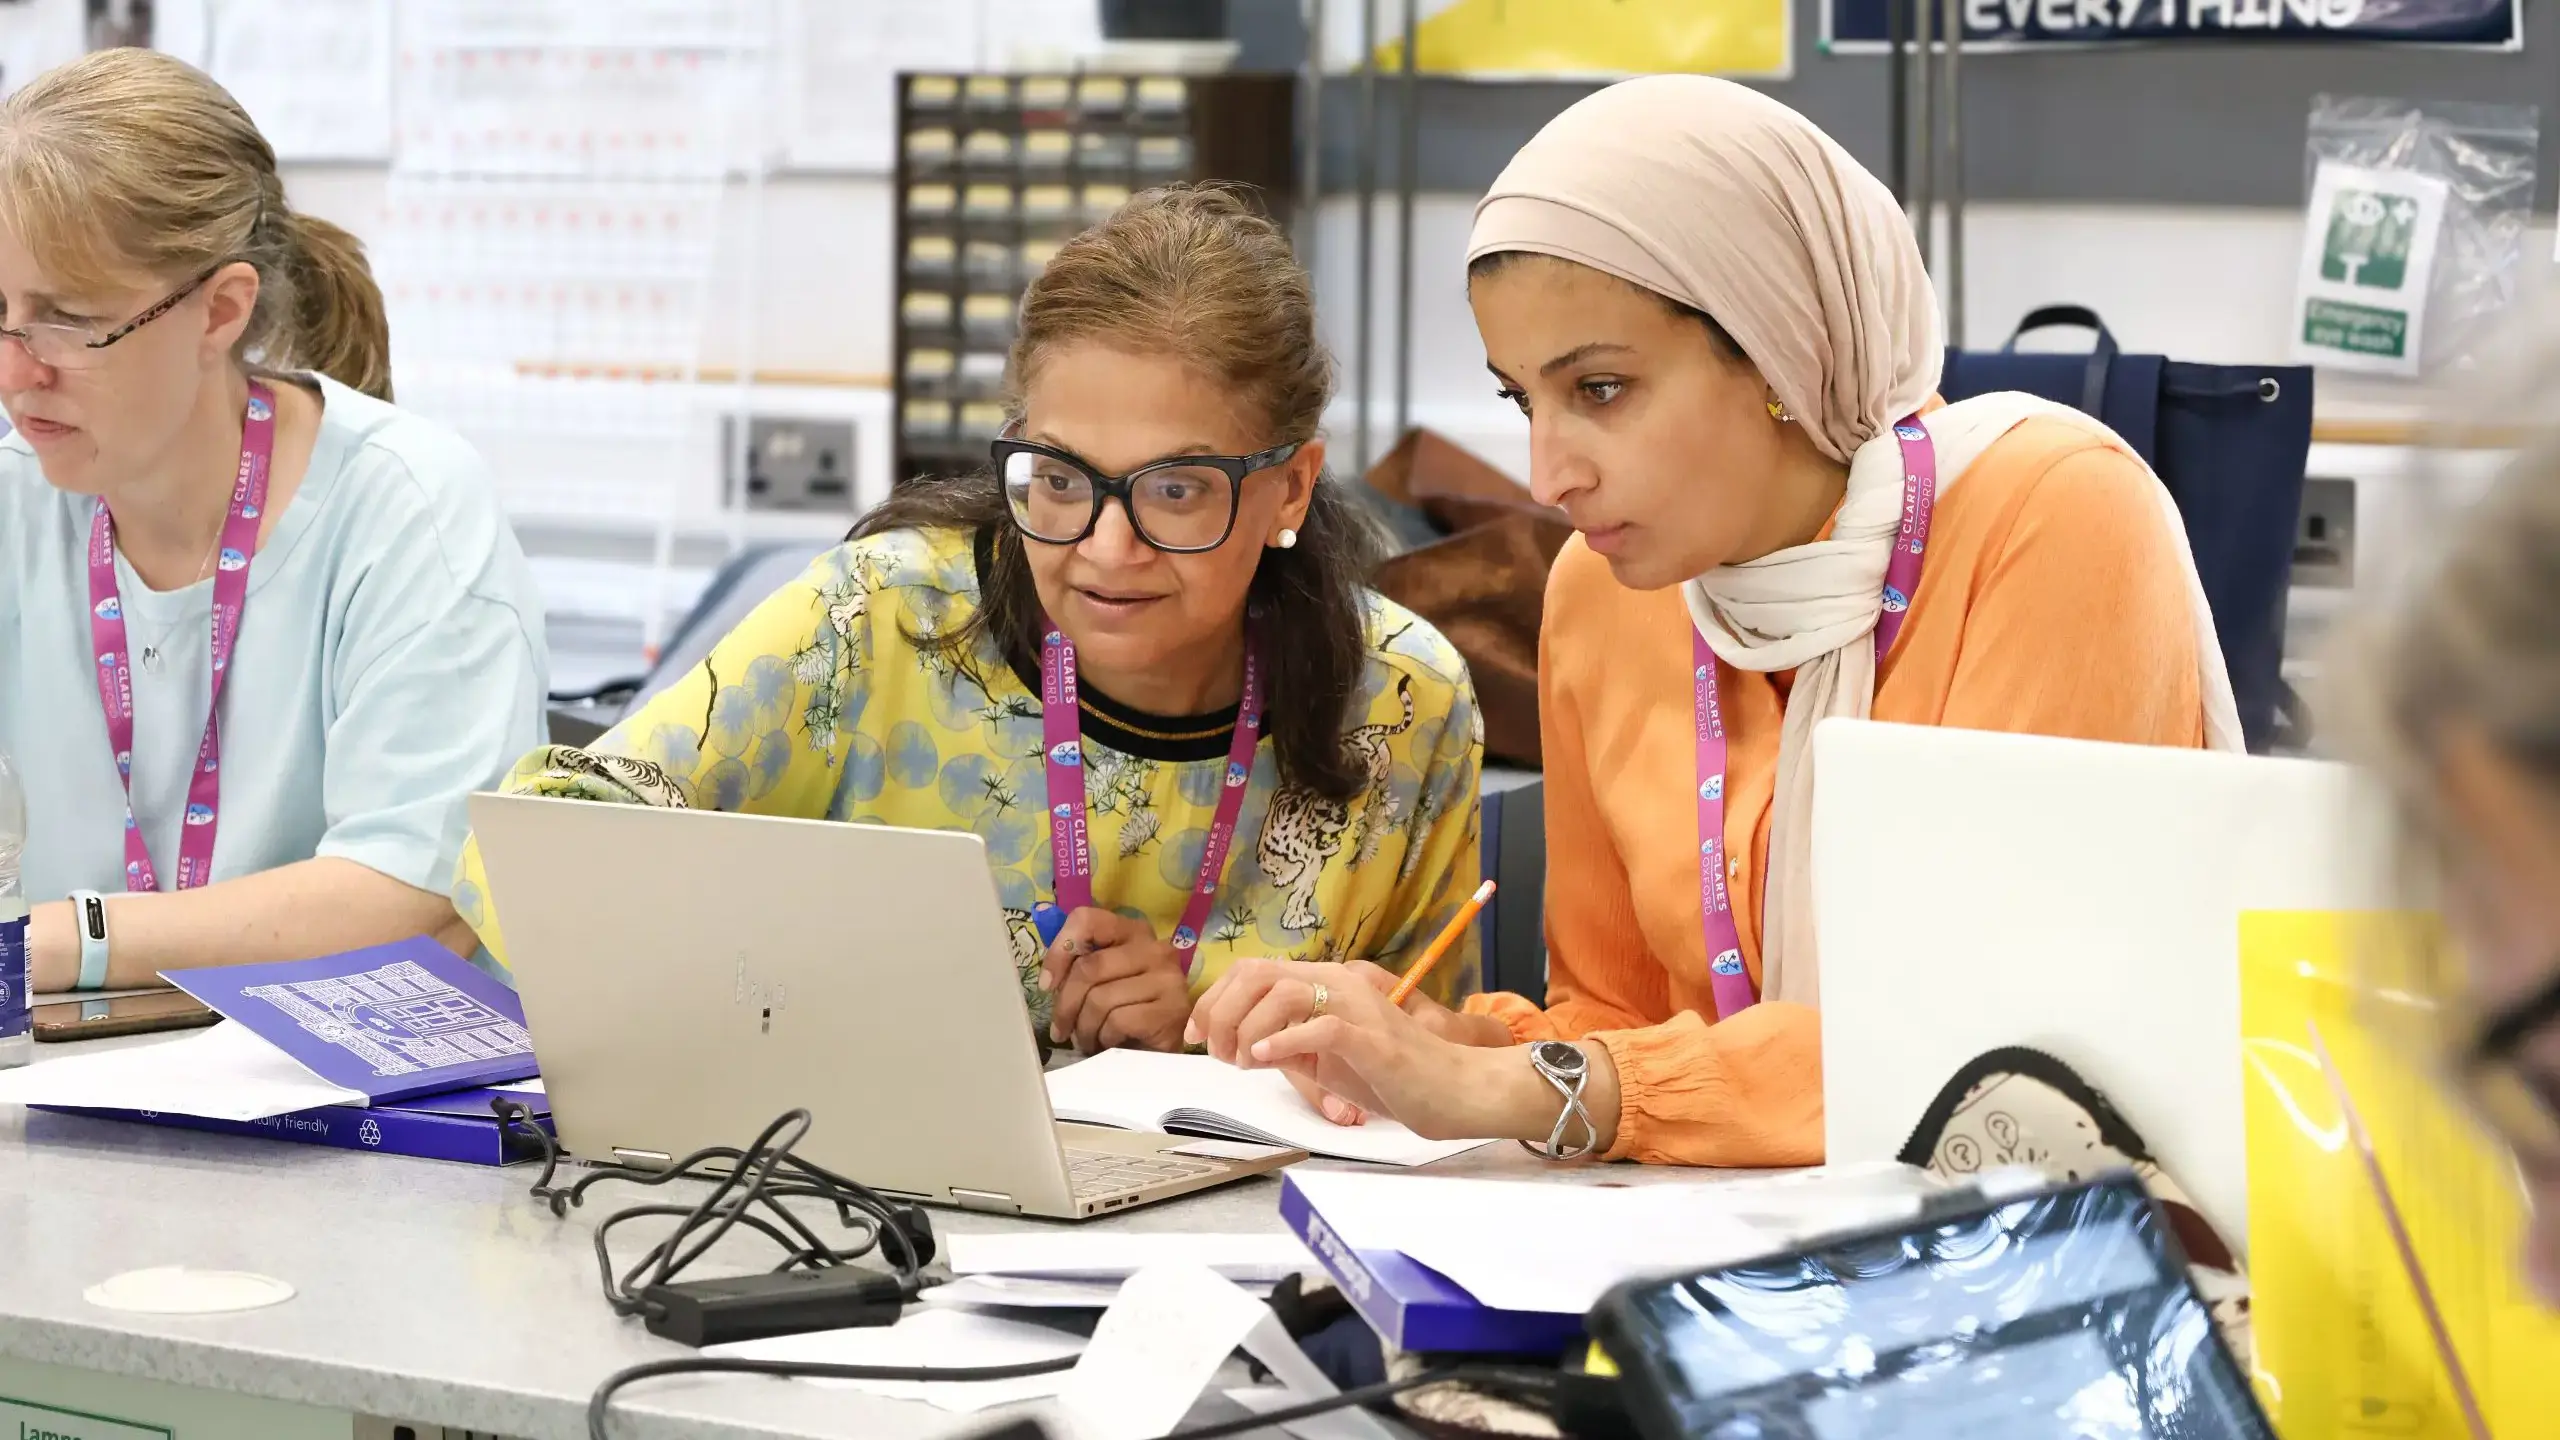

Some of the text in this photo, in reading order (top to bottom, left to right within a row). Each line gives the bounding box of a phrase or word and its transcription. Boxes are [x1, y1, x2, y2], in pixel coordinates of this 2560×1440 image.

[1965, 0, 2363, 29] EVERYTHING
[1917, 477, 1933, 538] OXFORD
[1897, 535, 1909, 552] ST
[1045, 647, 1058, 705] OXFORD
[1706, 662, 1716, 677] ST
[1696, 683, 1708, 742] OXFORD
[1072, 803, 1085, 816] ST
[1055, 820, 1070, 877] OXFORD
[1714, 836, 1722, 850] ST
[1702, 857, 1713, 915] OXFORD
[285, 1115, 329, 1136] friendly
[20, 1421, 82, 1440] Lam
